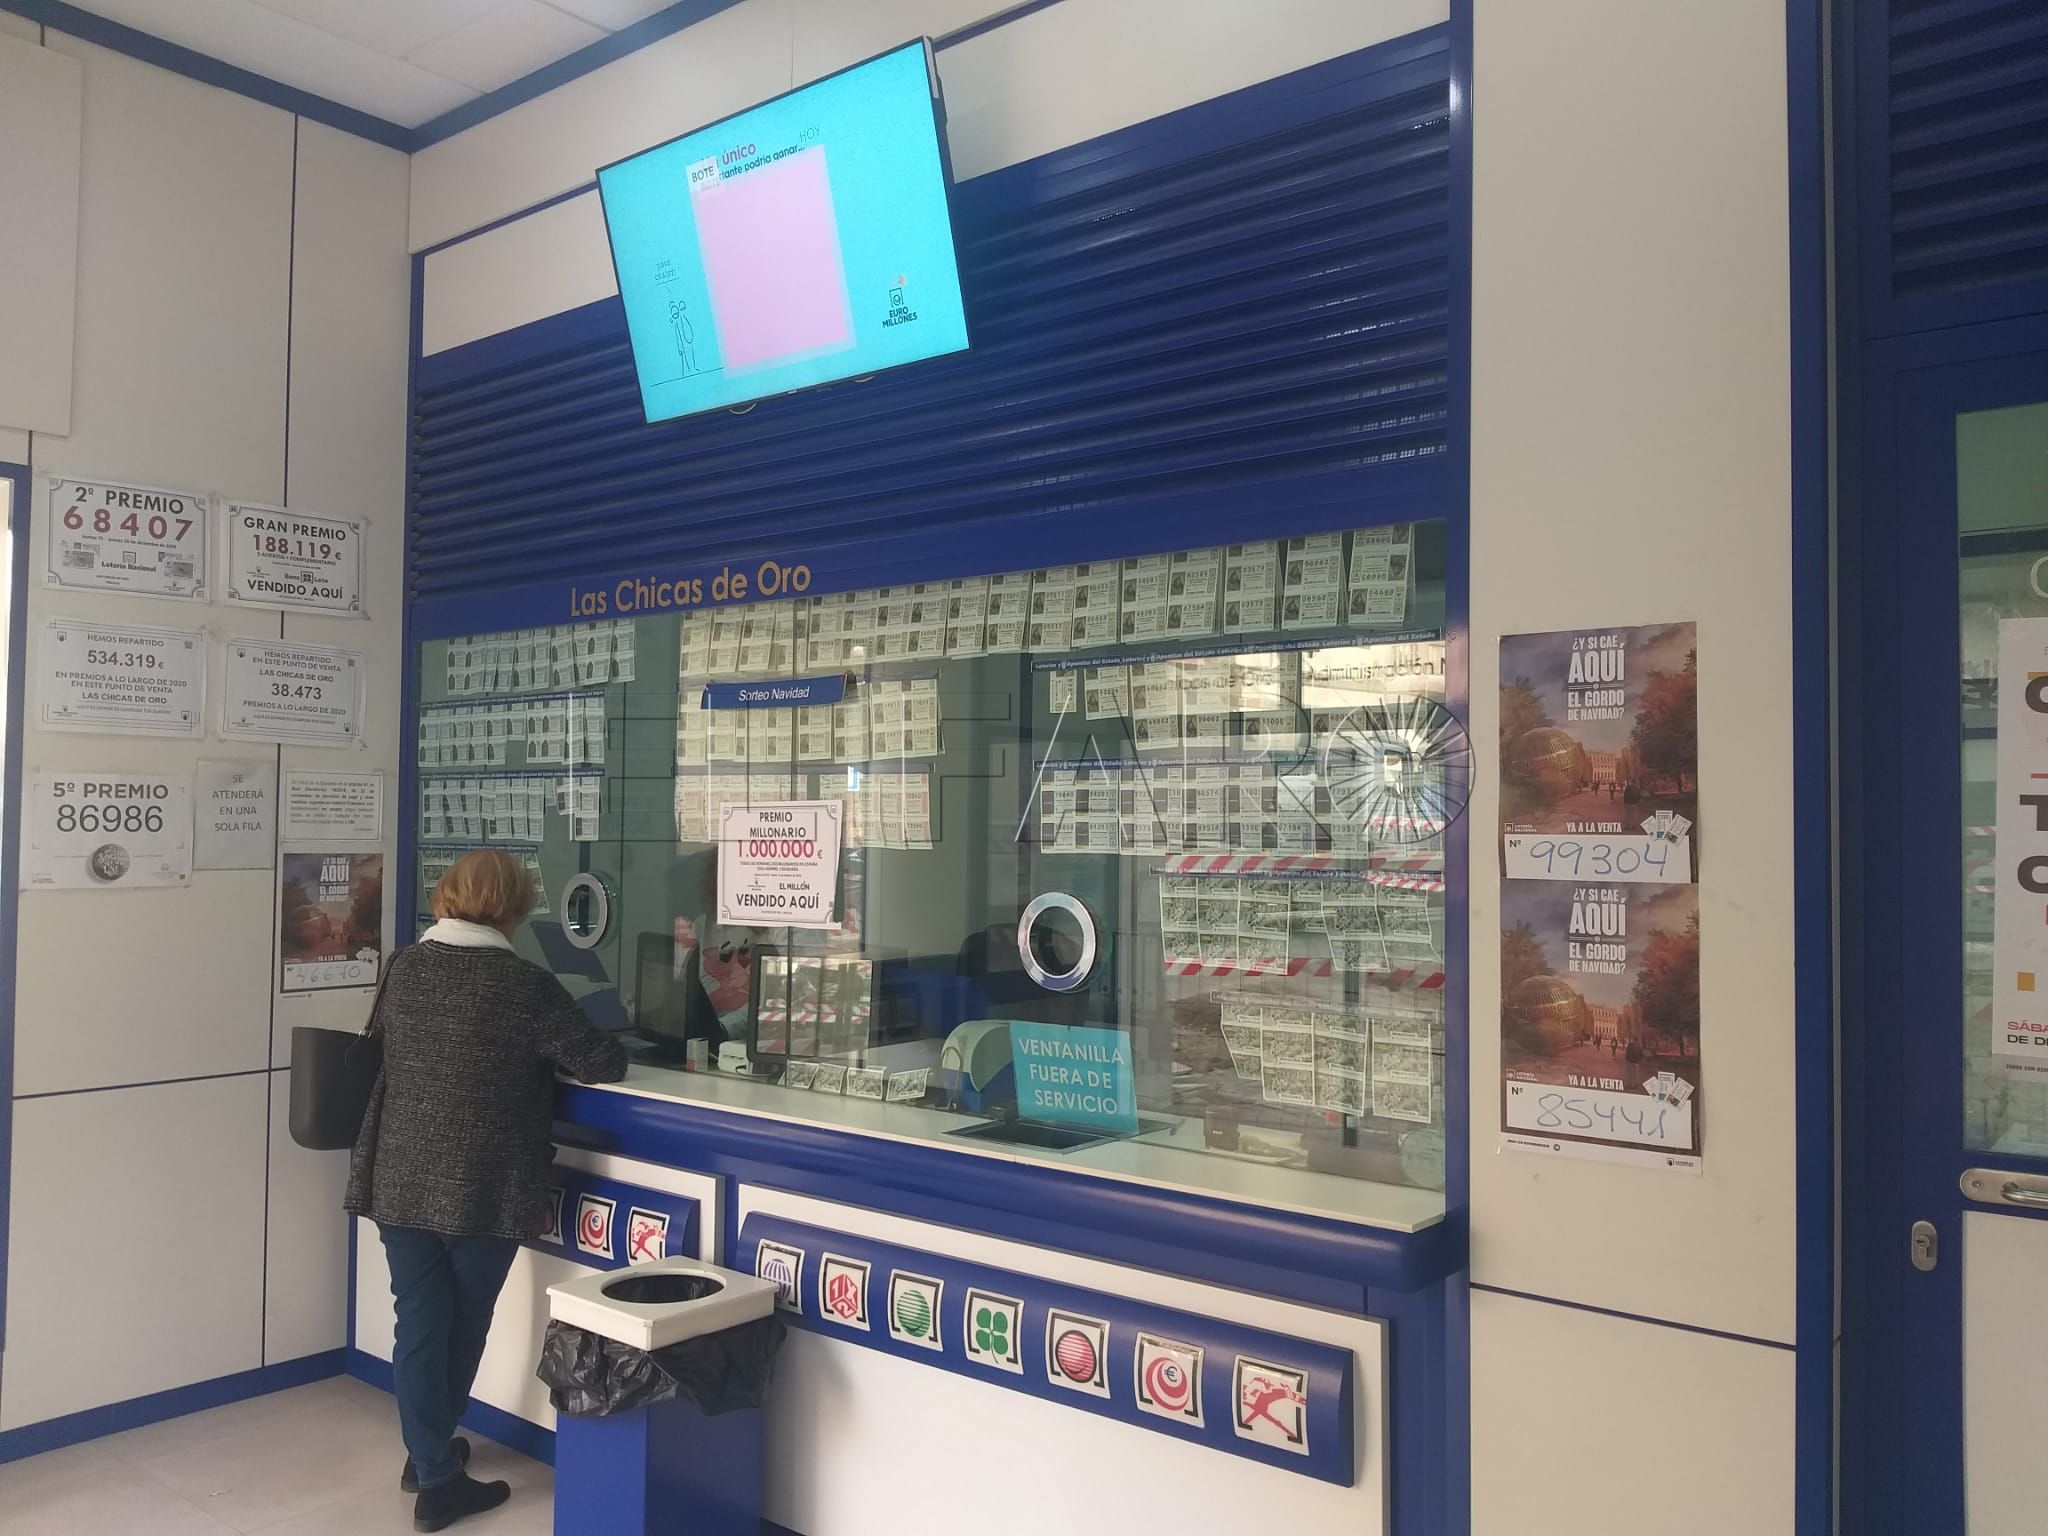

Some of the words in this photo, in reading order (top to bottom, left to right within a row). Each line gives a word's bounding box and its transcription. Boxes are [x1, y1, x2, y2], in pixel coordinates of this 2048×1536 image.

[800, 125, 820, 142] HOY
[722, 144, 756, 165] único
[744, 153, 772, 173] podría
[692, 166, 715, 182] BOTE
[882, 312, 918, 328] MILLONES
[888, 306, 908, 318] EURO
[75, 486, 94, 503] 2º
[105, 490, 184, 514] PREMIO
[63, 505, 194, 542] 68407
[244, 517, 288, 533] GRAN
[292, 524, 346, 540] PREMIO
[254, 534, 331, 559] 188.119
[247, 580, 306, 595] VENDIDO
[311, 586, 343, 599] AQUÍ
[571, 588, 607, 617] Las
[615, 576, 703, 612] Chicas
[712, 567, 748, 600] de
[758, 561, 811, 596] Oro
[88, 634, 117, 644] HEMOS
[119, 638, 164, 647] REPARTIDO
[1572, 637, 1586, 650] ¿Y
[1588, 636, 1598, 650] SI
[1600, 635, 1618, 649] CAE
[88, 650, 156, 668] 534.319
[265, 650, 290, 660] HEMOS
[292, 654, 332, 664] REPARTIDO
[265, 658, 281, 666] ESTE
[282, 660, 306, 668] PUNTO
[319, 664, 341, 672] VENTA
[1568, 642, 1625, 683] AQUÍ
[70, 672, 106, 682] PREMIOS
[128, 676, 155, 686] LARGO
[276, 670, 304, 680] CHICAS
[318, 674, 334, 682] ORO
[72, 680, 83, 688] EN
[105, 682, 133, 691] PUNTO
[147, 686, 174, 694] VENTA
[272, 682, 322, 700] 38.473
[738, 687, 770, 702] Sorteo
[771, 686, 810, 700] Navidad
[82, 692, 99, 700] LAS
[101, 693, 132, 702] CHICAS
[148, 696, 168, 704] ORO
[1568, 692, 1582, 708] EL
[1584, 690, 1625, 707] GORDO
[242, 700, 276, 709] PREMIOS
[294, 704, 318, 713] LARGO
[320, 706, 329, 714] DE
[1568, 710, 1579, 720] DE
[1580, 707, 1625, 720] NAVIDAD?
[233, 774, 244, 784] SE
[53, 782, 75, 798] 5º
[84, 783, 169, 800] PREMIO
[212, 788, 264, 799] ATENDERÁ
[56, 804, 164, 832] 86986
[220, 806, 233, 815] EN
[236, 806, 257, 816] UNA
[760, 812, 793, 822] PREMIO
[215, 822, 240, 832] SOLA
[242, 822, 262, 830] FILA
[750, 827, 806, 838] MILLONARIO
[1566, 822, 1577, 833] YA
[1578, 822, 1584, 833] A
[1586, 822, 1596, 833] LA
[1596, 822, 1622, 833] VENTA
[738, 839, 814, 858] 1.000.000
[1509, 839, 1522, 848] Nº
[1530, 840, 1668, 877] 99304
[320, 860, 350, 882] AQUÍ
[786, 881, 810, 890] MILLÓN
[736, 894, 786, 908] VENDIDO
[790, 892, 820, 908] AQUÍ
[1574, 888, 1586, 900] ¿Y
[1588, 888, 1598, 902] SI
[1600, 889, 1620, 902] CAE
[1569, 898, 1626, 936] AQUÍ
[1569, 942, 1582, 958] EL
[1586, 943, 1626, 962] GORDO
[1569, 960, 1580, 972] DE
[1582, 960, 1626, 975] NAVIDAD?
[2008, 1034, 2029, 1044] DE
[1018, 1038, 1124, 1065] VENTANILLA
[1030, 1064, 1084, 1086] FUERA
[1088, 1070, 1112, 1089] DE
[1568, 1074, 1578, 1086] YA
[1580, 1076, 1586, 1086] A
[1588, 1076, 1598, 1088] LA
[1599, 1077, 1624, 1091] VENTA
[1511, 1086, 1524, 1096] Nº
[1034, 1088, 1118, 1115] SERVICIO
[1536, 1093, 1666, 1138] 85441
